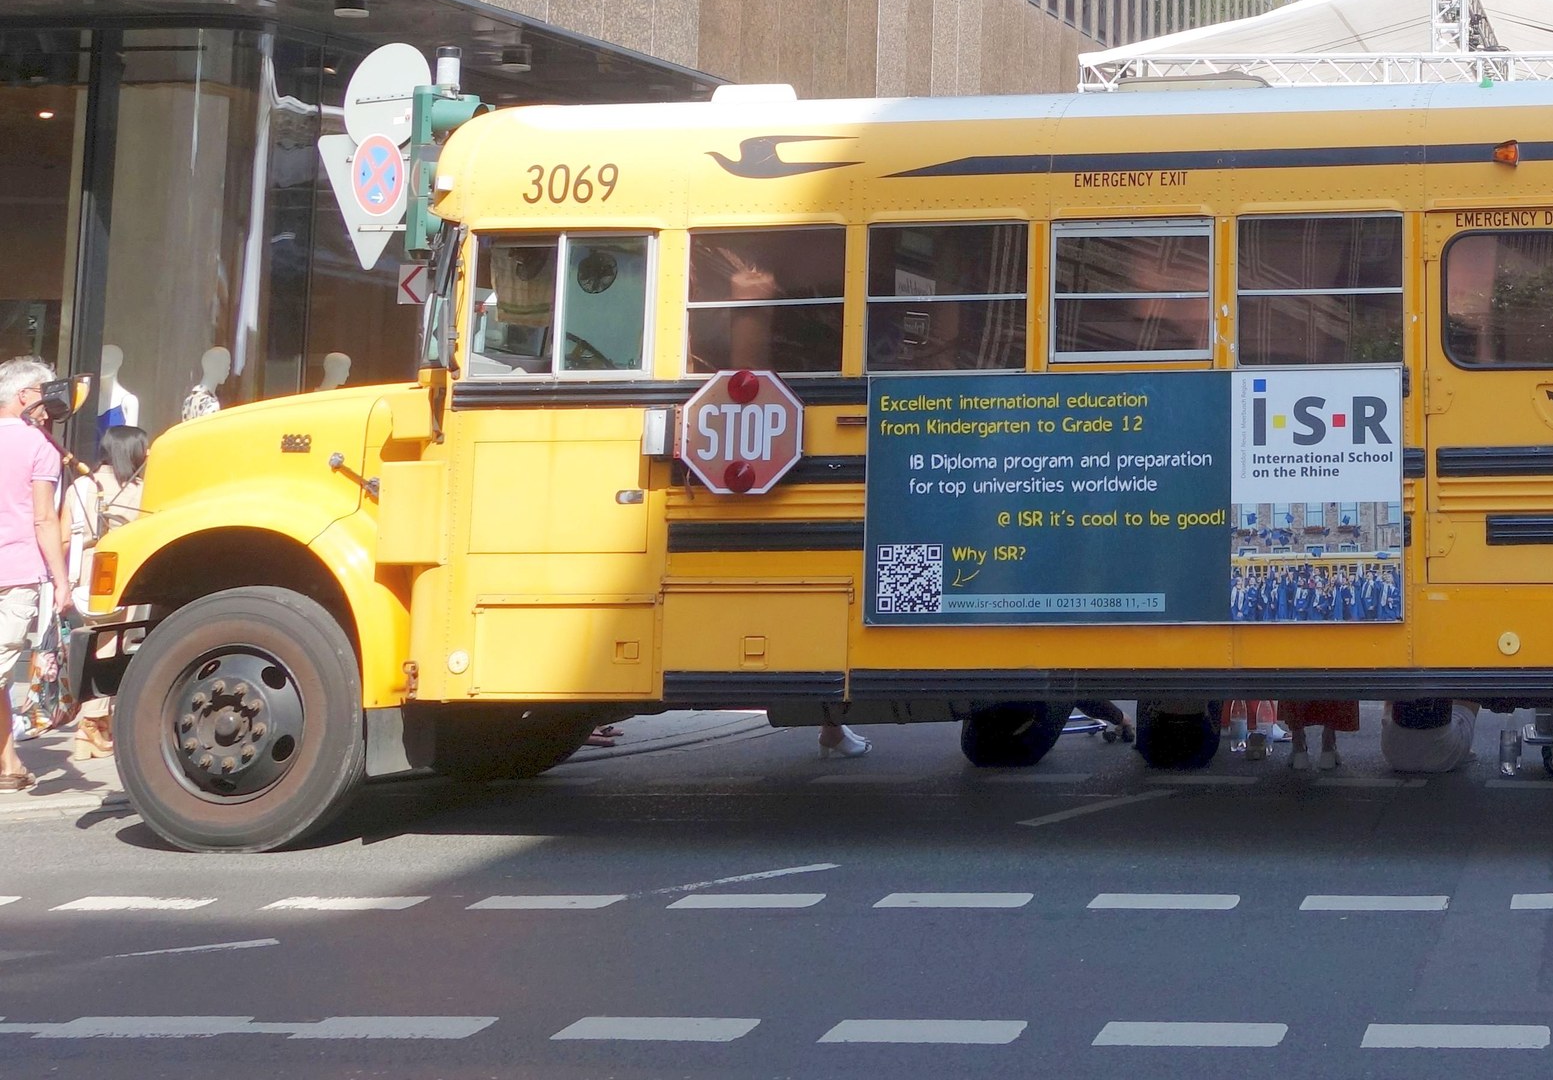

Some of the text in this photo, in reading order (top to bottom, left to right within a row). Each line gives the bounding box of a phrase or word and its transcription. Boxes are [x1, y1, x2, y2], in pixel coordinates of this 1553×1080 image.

[522, 163, 619, 205] 3069
[1074, 171, 1187, 187] EMERGENCY EXIT
[1455, 211, 1536, 227] EMERGENCY
[880, 392, 1148, 412] Excellent international education
[697, 403, 787, 462] STOP
[880, 421, 920, 436] from
[927, 418, 1030, 437] Kindergarten
[1037, 419, 1055, 434] to
[1062, 416, 1113, 432] Grade
[910, 450, 1212, 473] IB Diploma program and preparation
[1253, 451, 1393, 464] International School
[1252, 466, 1340, 478] on the Rhine
[910, 475, 1157, 497] for top universities worldwide
[998, 512, 1011, 526] @
[1018, 511, 1043, 526] ISR
[1082, 510, 1117, 526] cool
[1124, 510, 1143, 525] to
[1149, 510, 1170, 525] be
[1177, 509, 1226, 529] good!
[952, 546, 1026, 565] Why ISR?
[948, 598, 1041, 609] www.isr-school.de
[1057, 598, 1088, 608] 02131
[1090, 598, 1122, 608] 40388
[1125, 598, 1140, 610] 11,
[1142, 598, 1159, 608] -15
